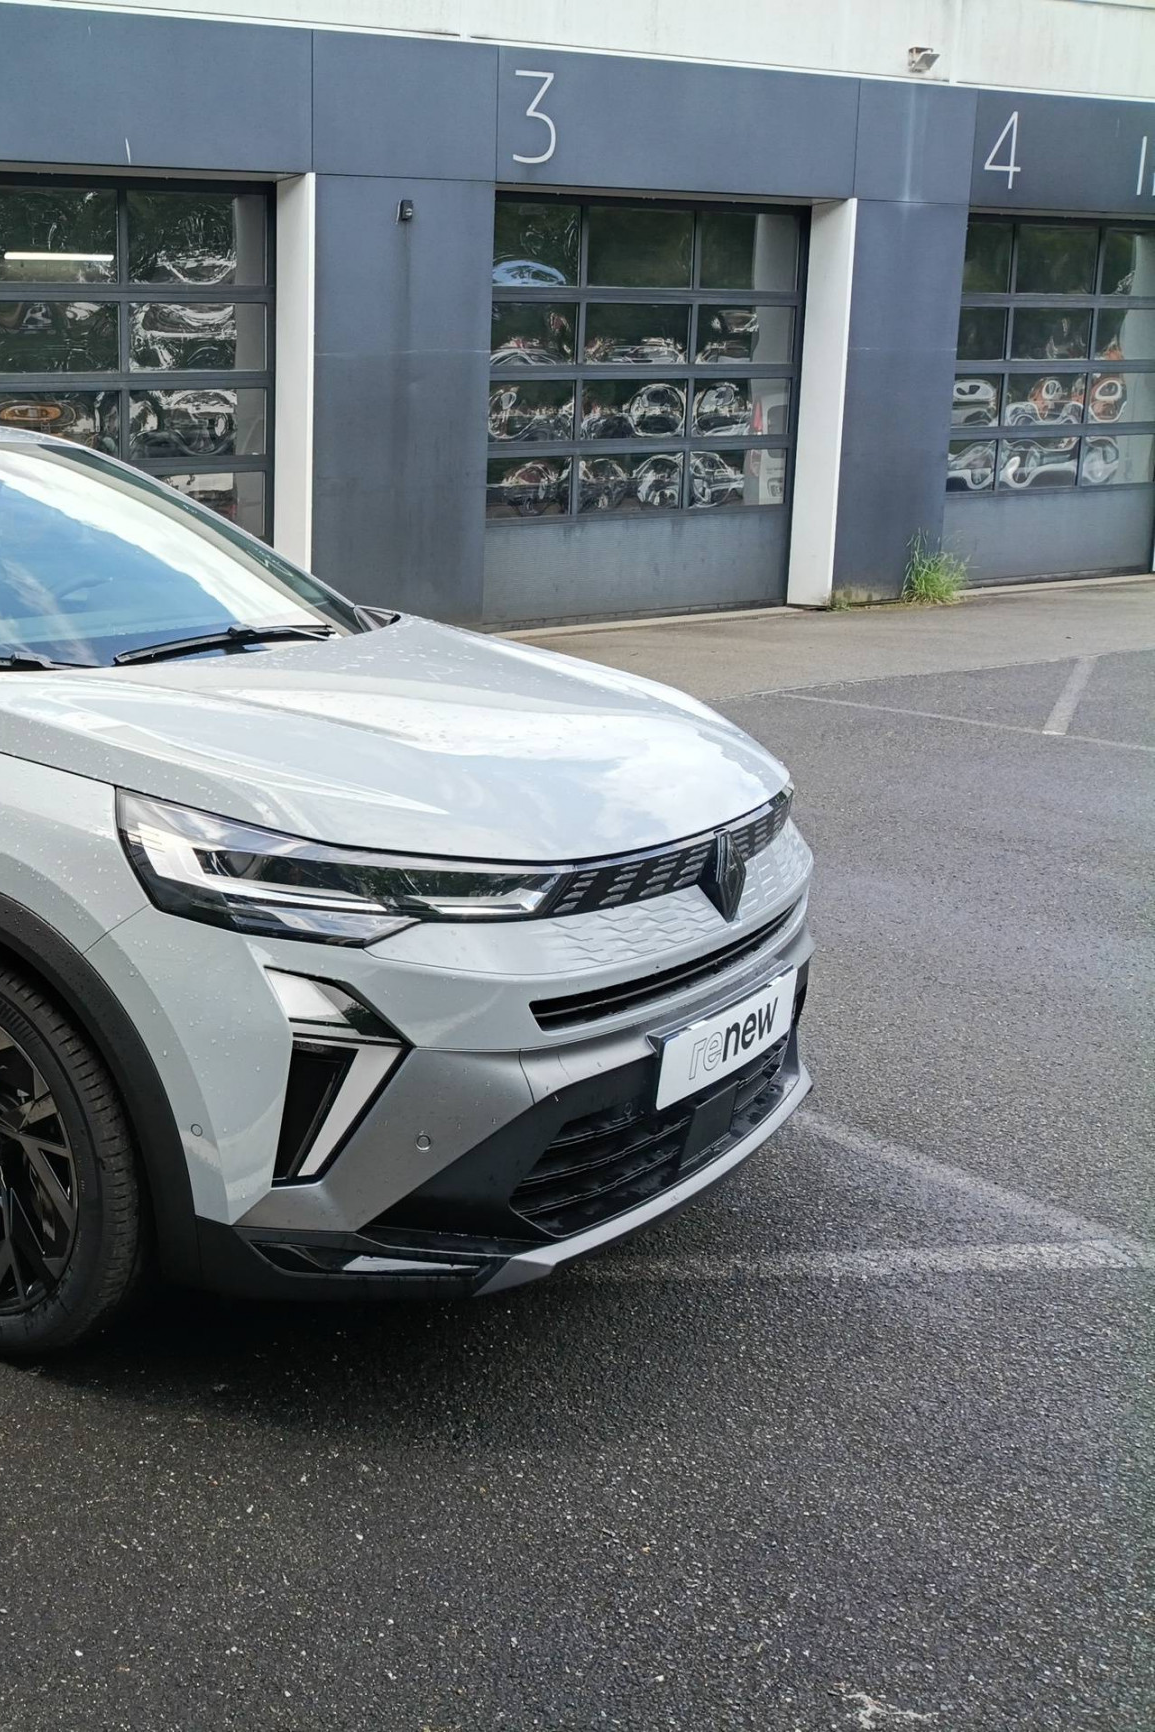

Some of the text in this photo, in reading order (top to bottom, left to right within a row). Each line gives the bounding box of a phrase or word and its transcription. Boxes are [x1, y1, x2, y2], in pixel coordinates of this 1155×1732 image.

[512, 69, 557, 164] 3
[984, 111, 1021, 189] 4
[689, 997, 778, 1081] renew
